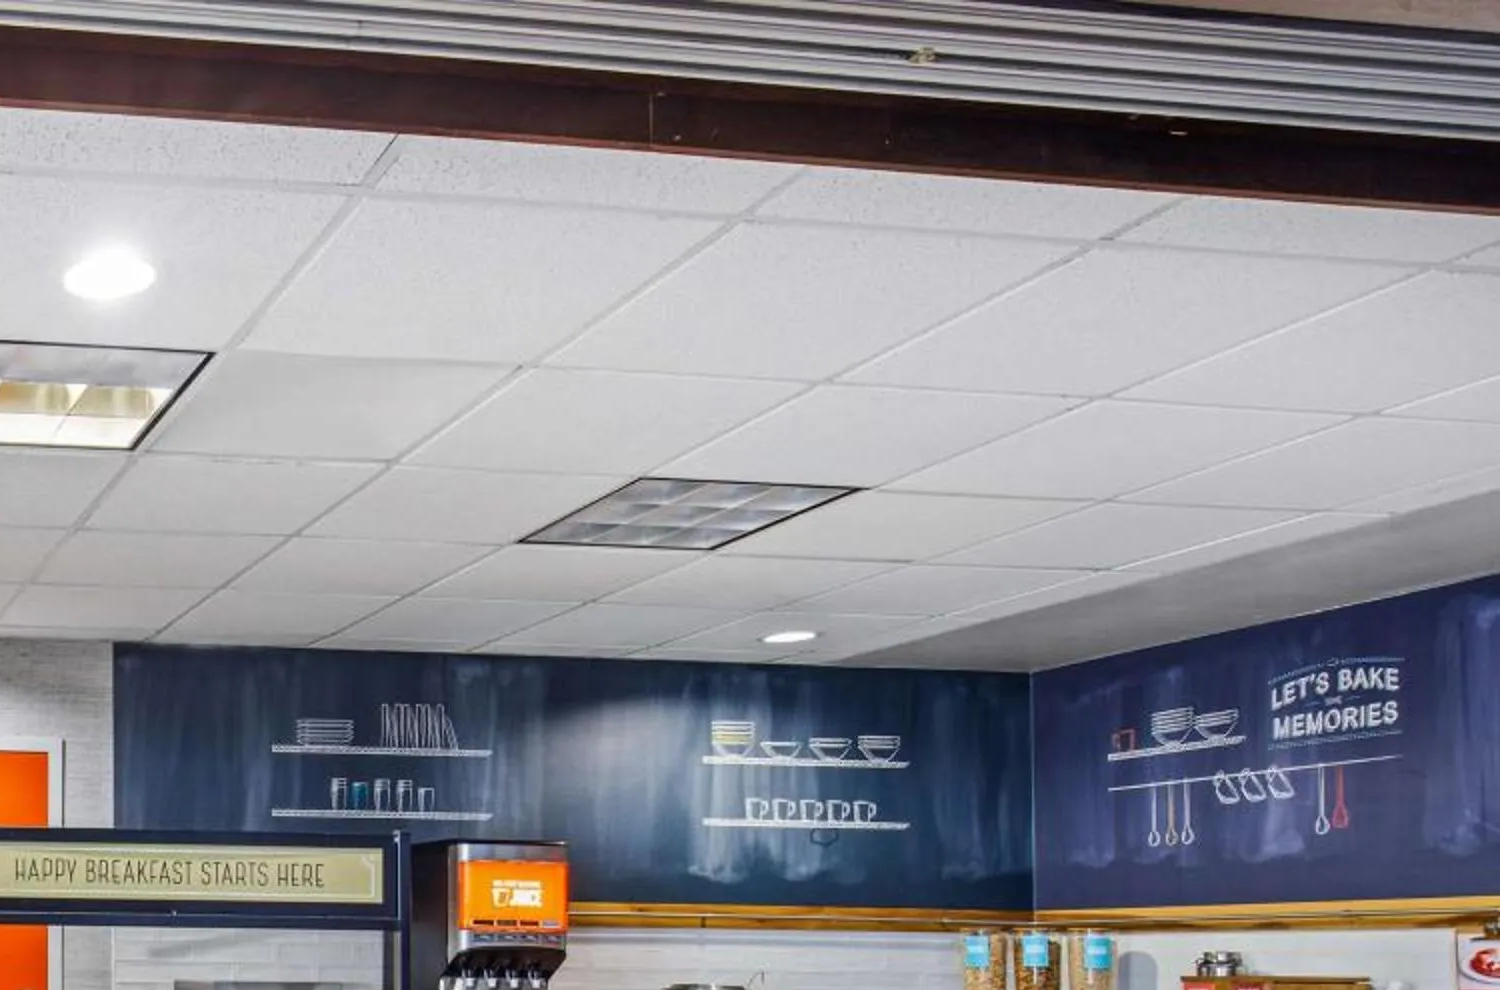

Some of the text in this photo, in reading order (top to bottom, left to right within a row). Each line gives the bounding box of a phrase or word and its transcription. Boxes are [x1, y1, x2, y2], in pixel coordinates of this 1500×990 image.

[1270, 666, 1400, 711] LET'S BAKE
[1272, 700, 1400, 741] MEMORIES
[14, 858, 325, 888] HAPPY BREAKFAST STARTS HERE
